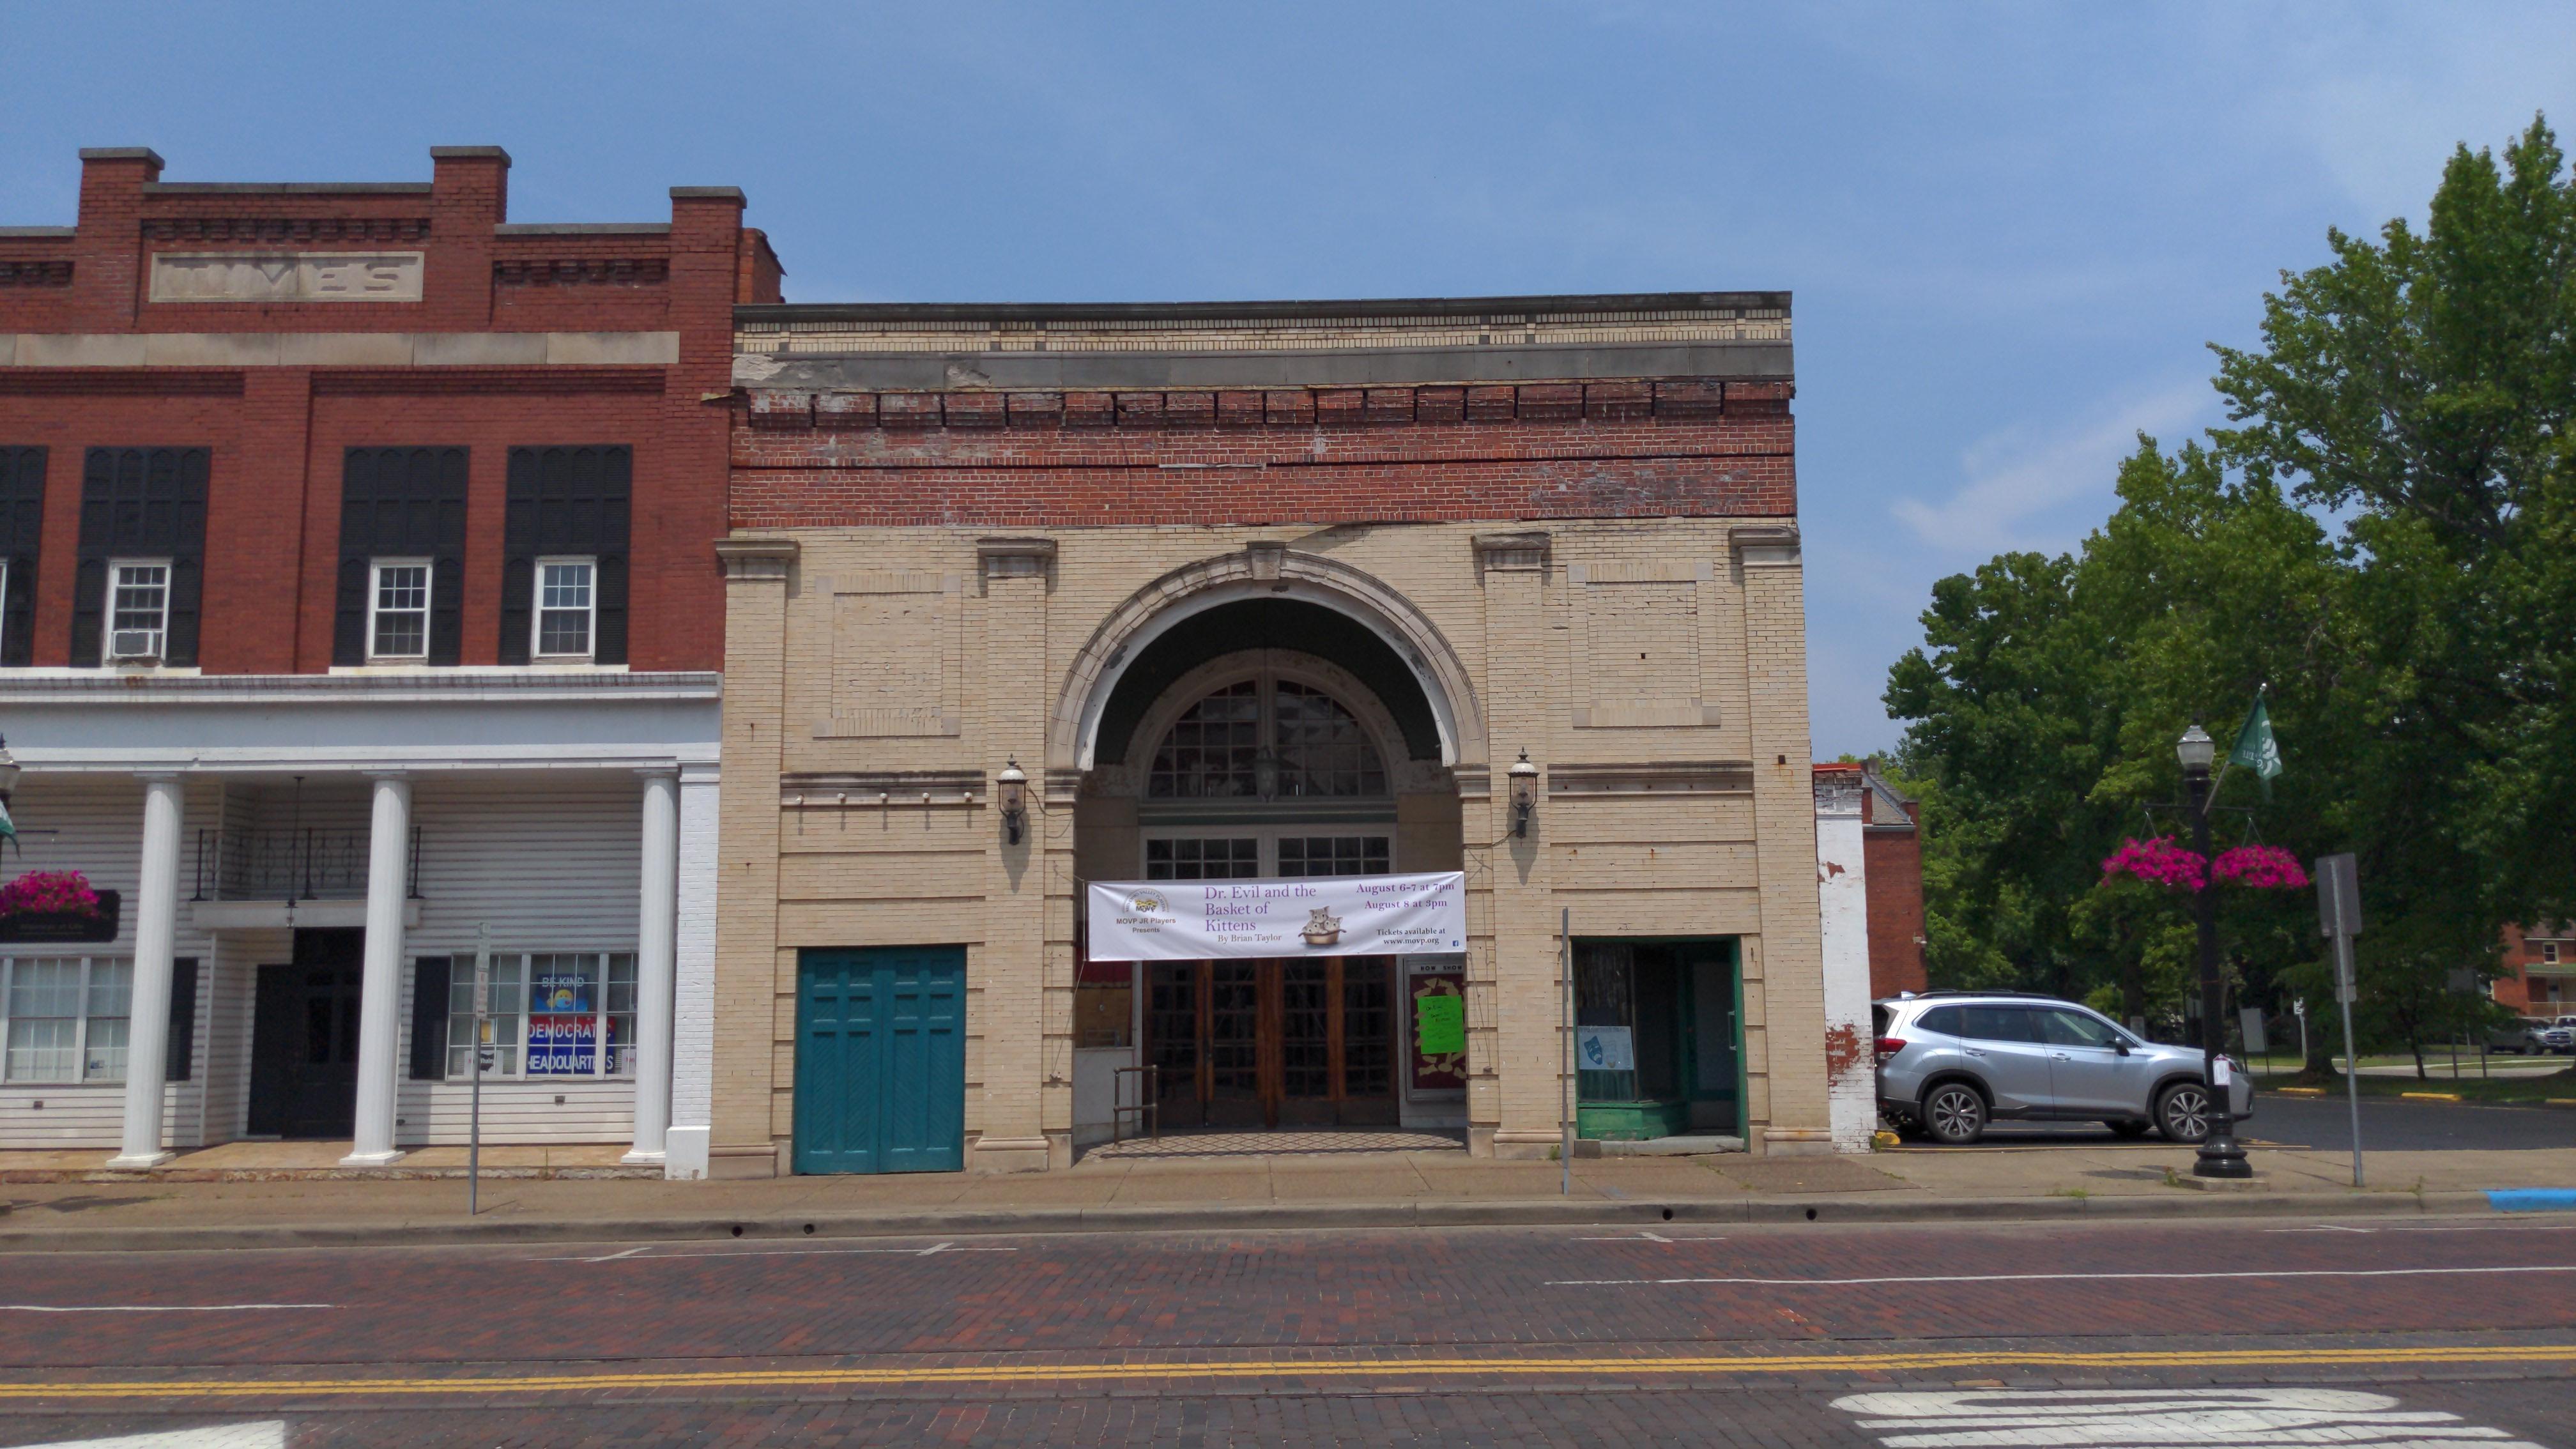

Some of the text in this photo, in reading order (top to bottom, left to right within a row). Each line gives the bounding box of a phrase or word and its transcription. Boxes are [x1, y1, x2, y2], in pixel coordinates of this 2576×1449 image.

[1206, 884, 1316, 899] Dr. Evil and the
[1356, 884, 1395, 895] August
[1433, 883, 1454, 893] 7pm
[1206, 901, 1270, 916] Basket of
[1365, 900, 1400, 912] August
[1425, 900, 1447, 910] 3pm
[1206, 919, 1256, 931] Kittens
[1218, 933, 1282, 944] By Brian Taylor
[542, 977, 584, 987] BE KIND
